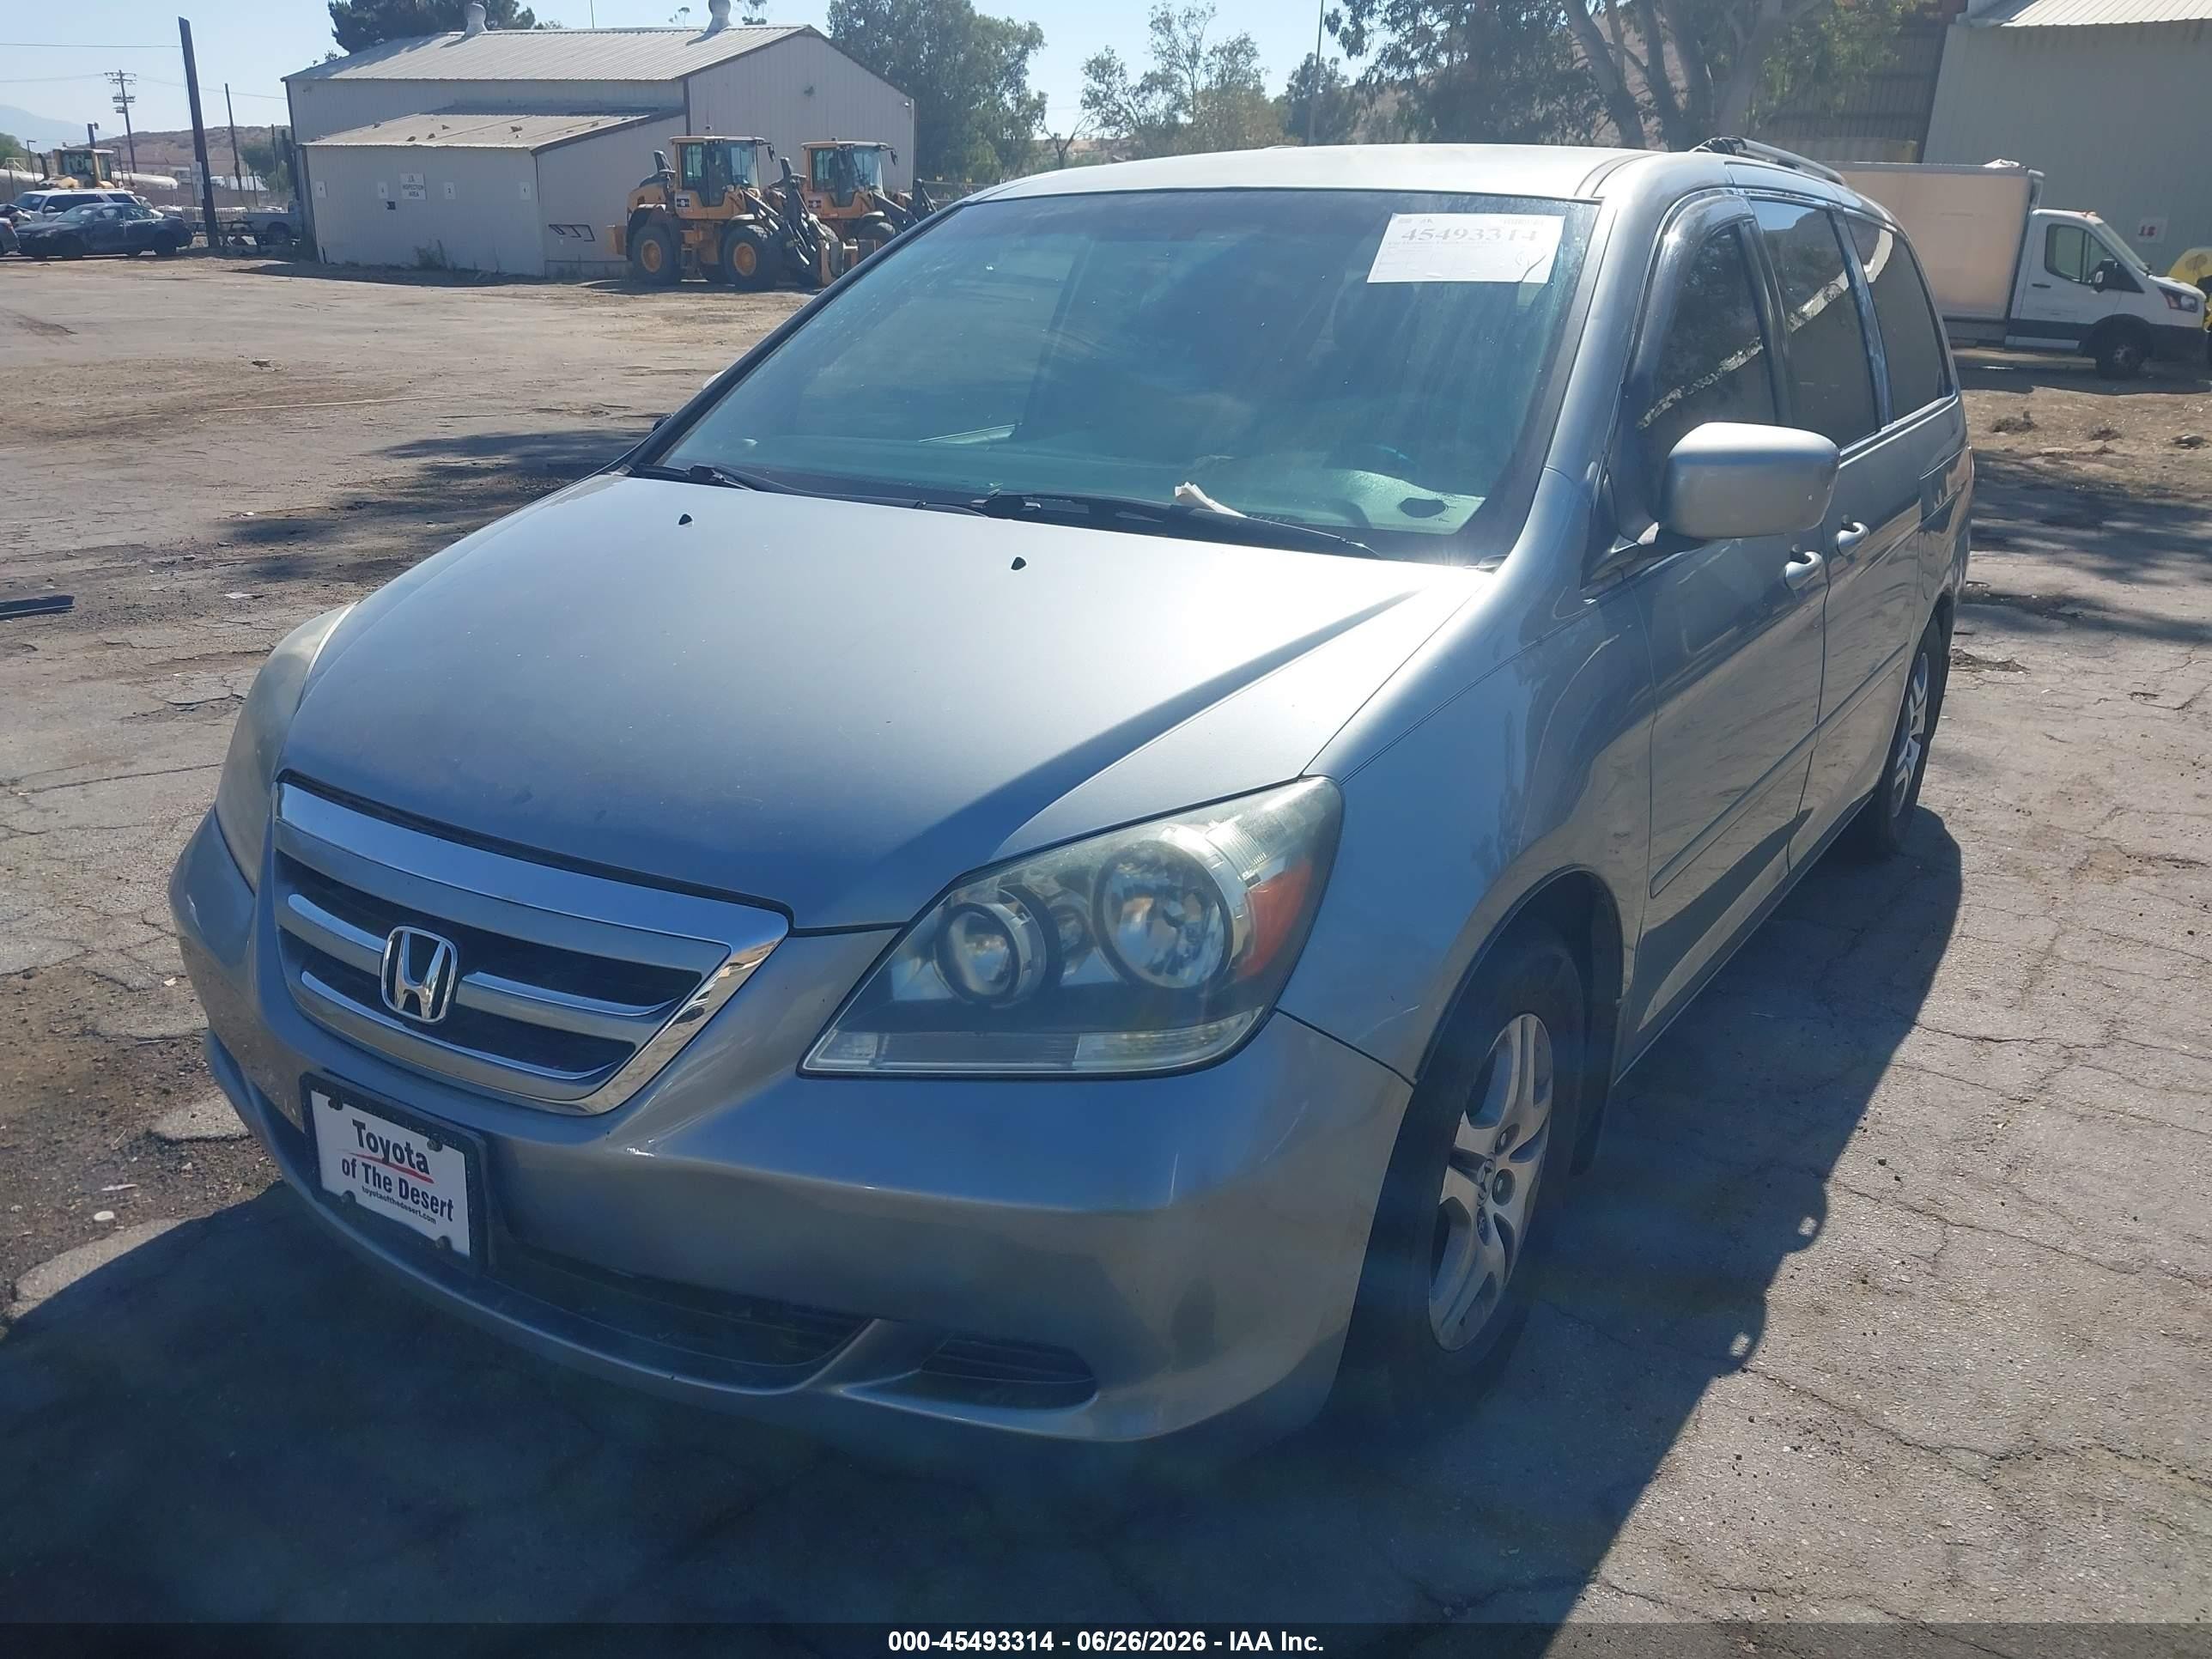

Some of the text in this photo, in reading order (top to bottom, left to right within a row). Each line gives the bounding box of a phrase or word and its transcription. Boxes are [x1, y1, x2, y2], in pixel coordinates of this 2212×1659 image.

[1401, 227, 1539, 241] 45493314
[352, 1119, 430, 1175] Toyota
[342, 1158, 453, 1222] of The Desert
[362, 1186, 437, 1224] toyotaofthedesert.com
